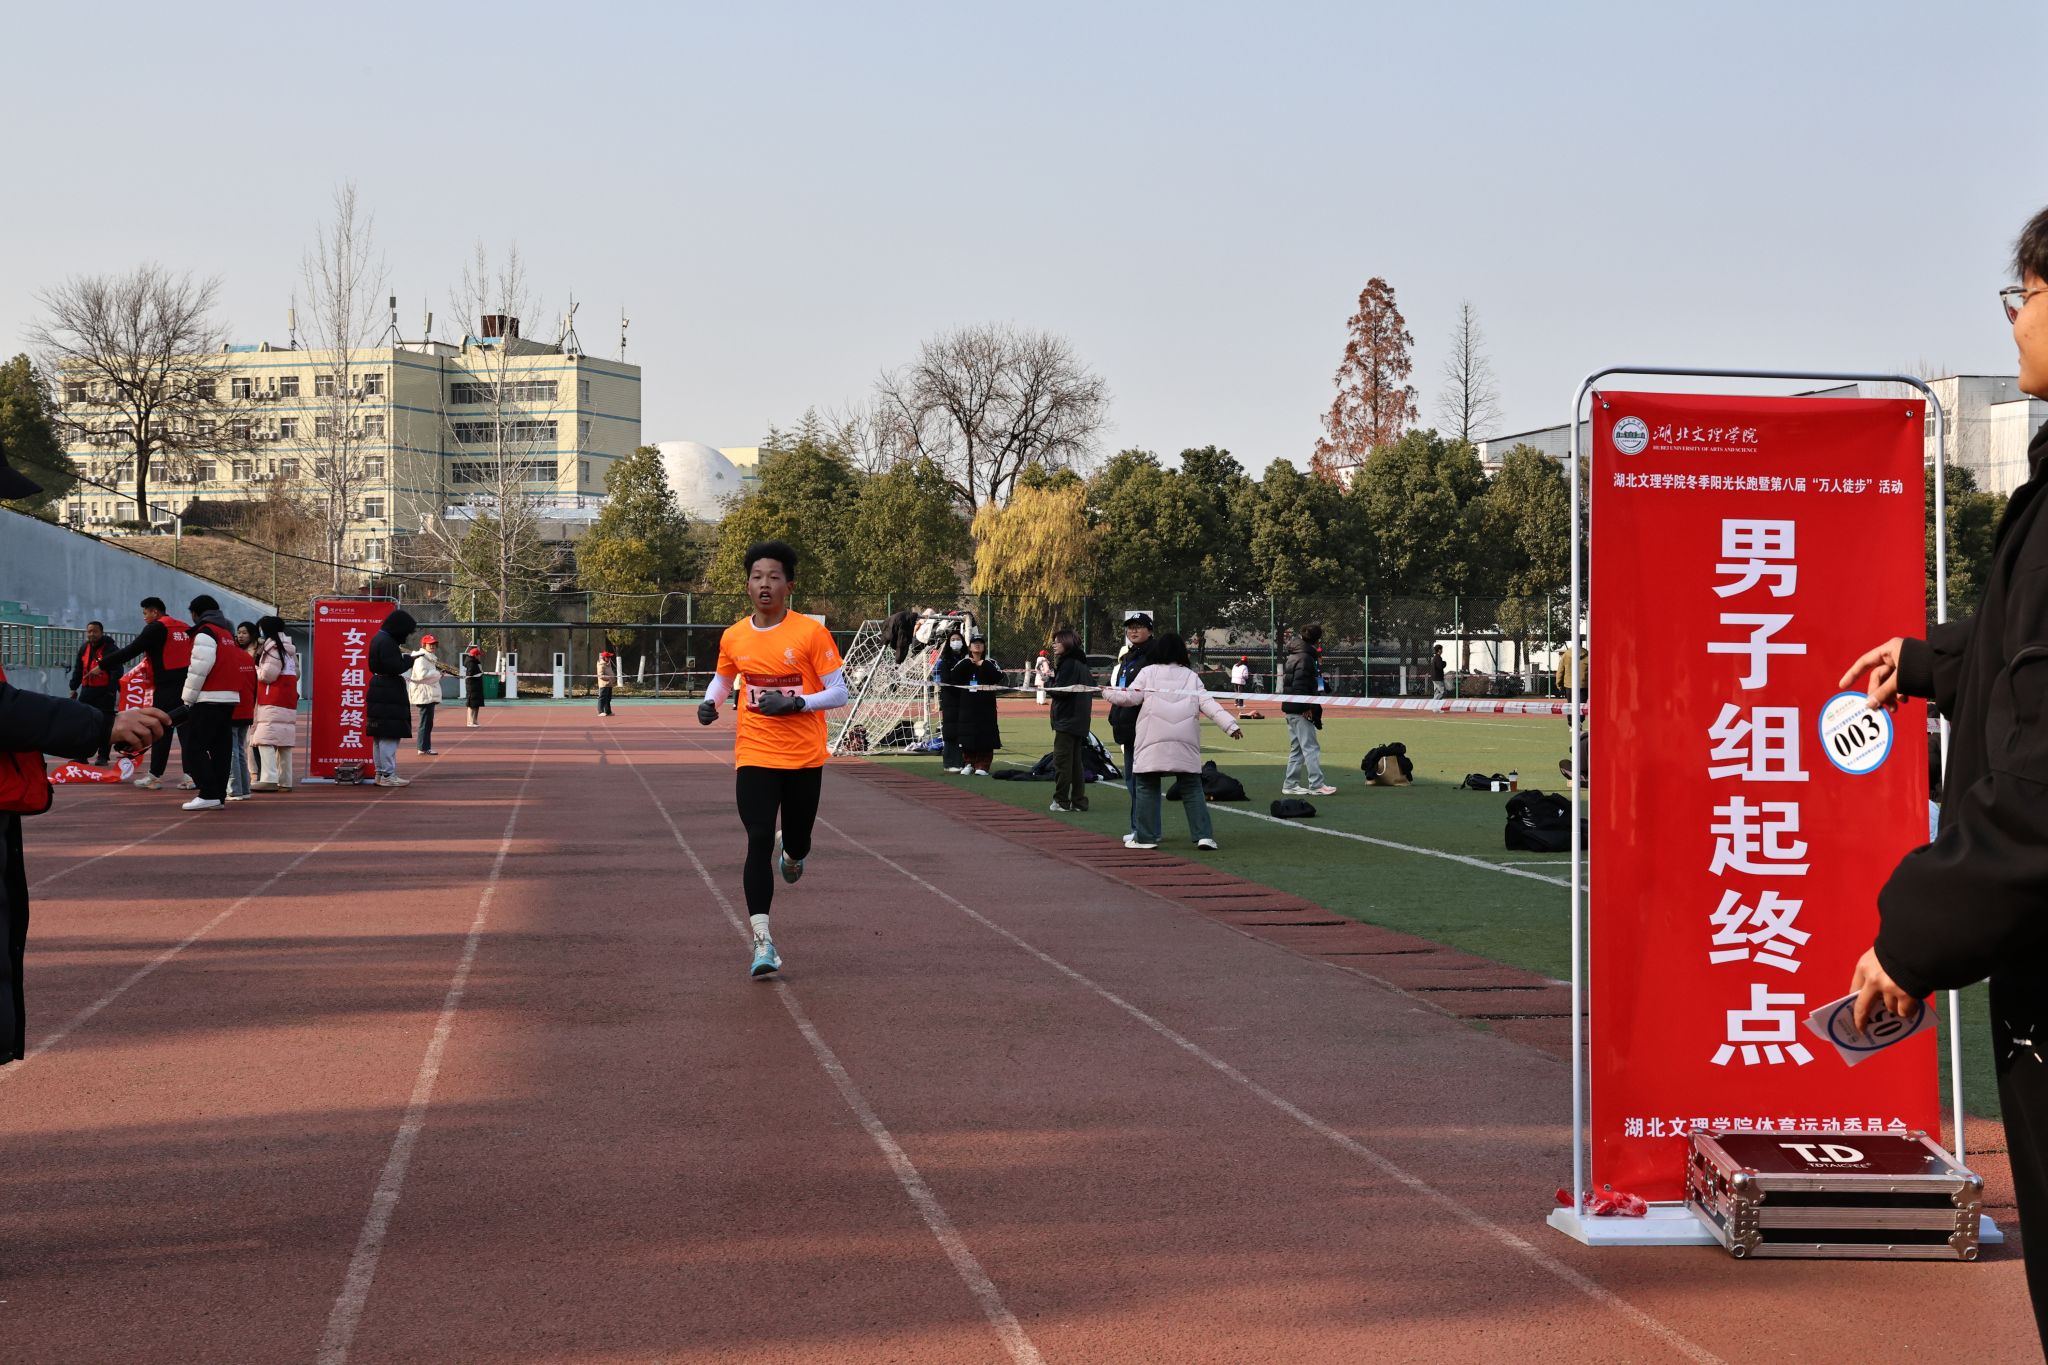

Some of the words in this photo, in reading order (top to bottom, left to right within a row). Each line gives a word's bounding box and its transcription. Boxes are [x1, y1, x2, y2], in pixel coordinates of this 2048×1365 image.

[1652, 423, 1759, 444] 湖北文理学院
[338, 627, 367, 749] 女子组起终点
[1834, 714, 1880, 757] 003
[1707, 518, 1815, 1067] 男子组起终点
